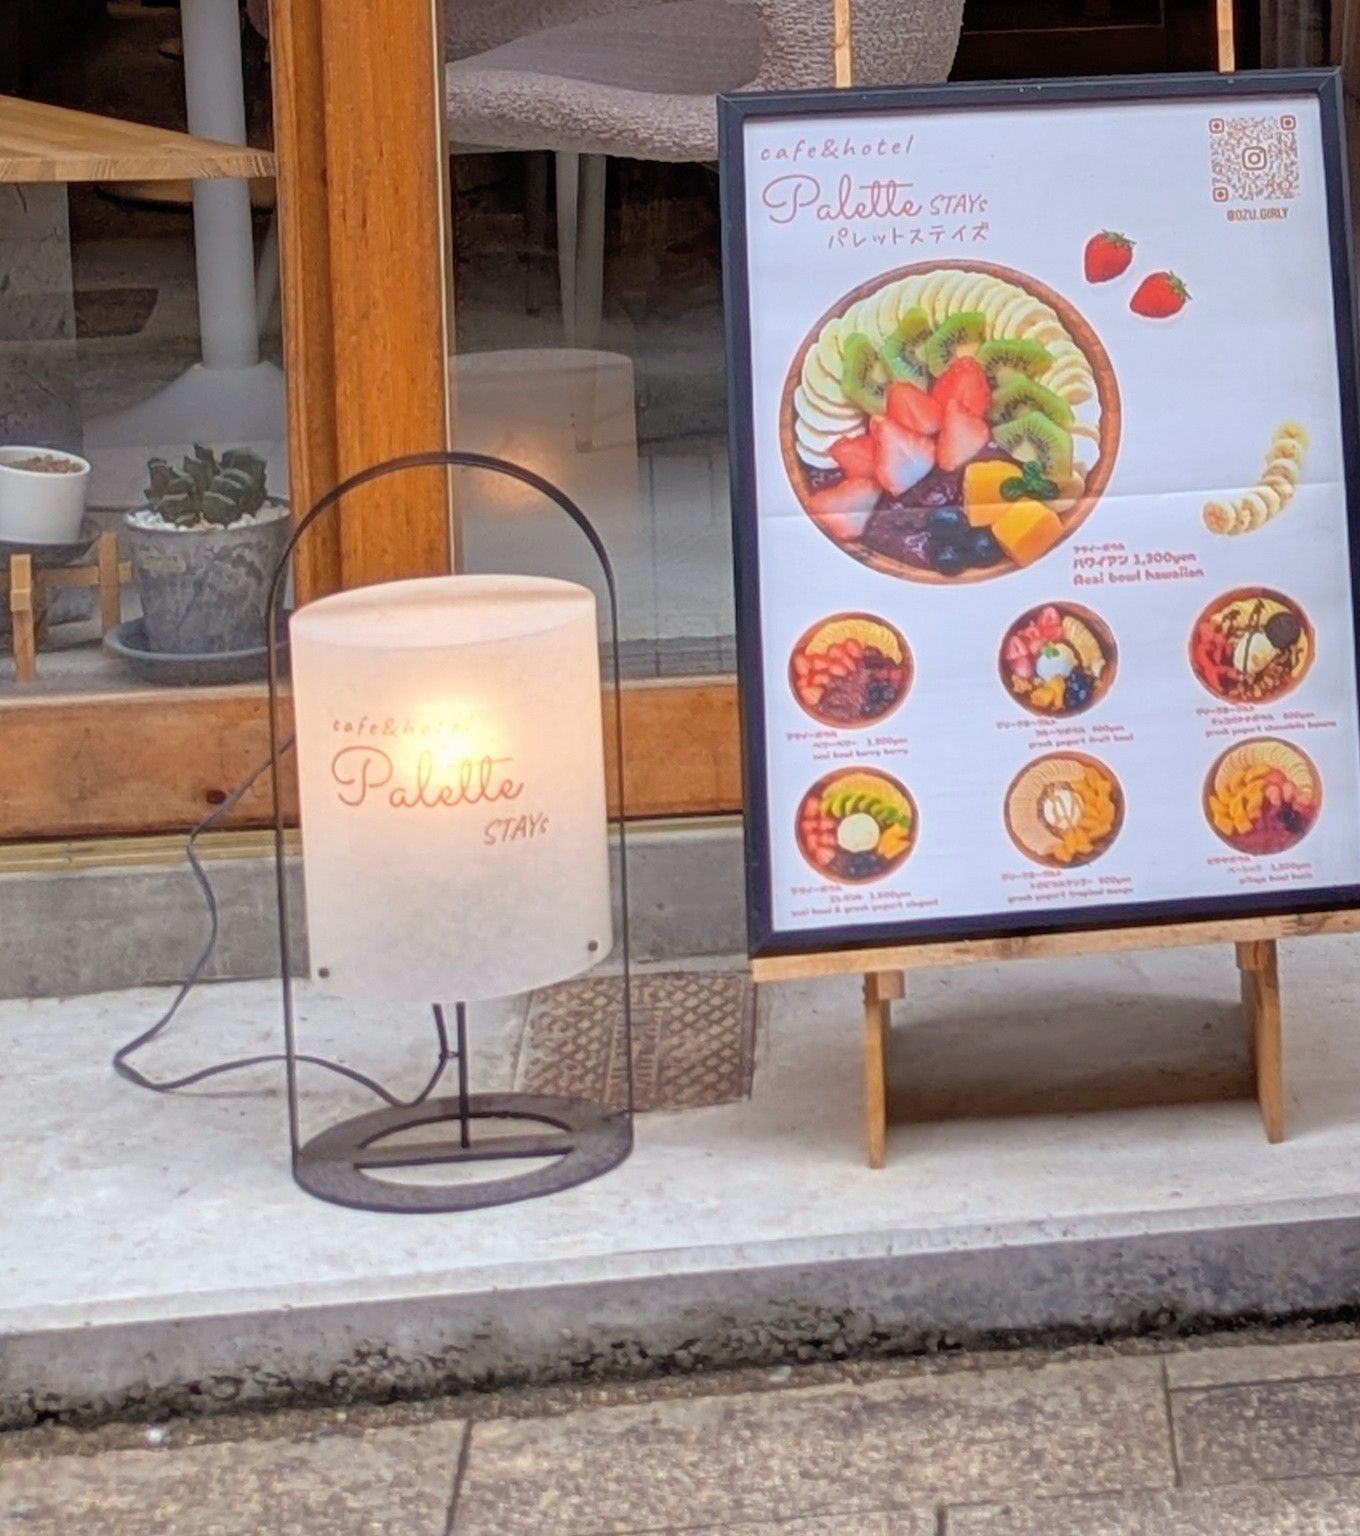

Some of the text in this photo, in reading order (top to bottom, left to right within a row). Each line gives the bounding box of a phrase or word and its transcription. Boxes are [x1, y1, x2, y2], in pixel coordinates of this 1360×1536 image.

[761, 135, 914, 161] cafe&hotel
[762, 173, 922, 224] Palette
[828, 222, 989, 248] パレットステイズ
[331, 745, 525, 808] Palette
